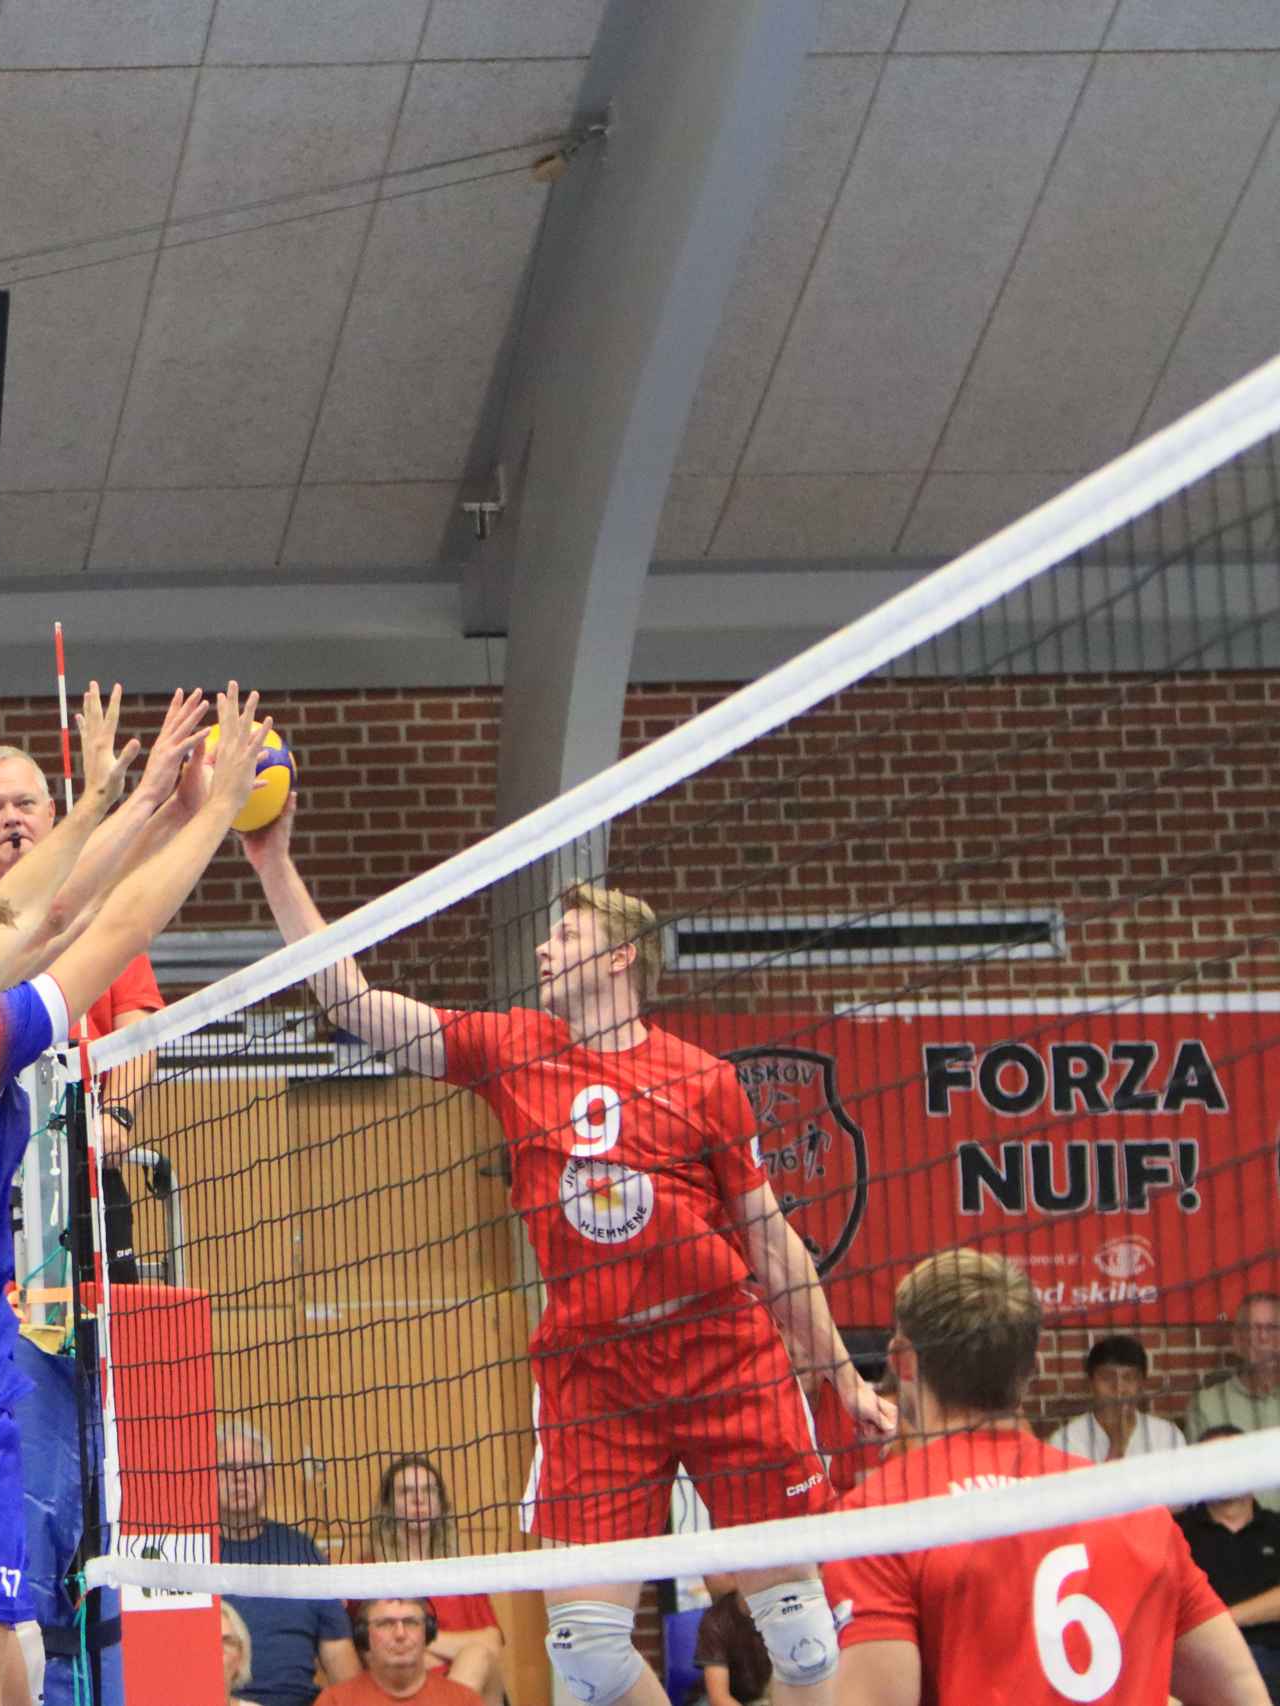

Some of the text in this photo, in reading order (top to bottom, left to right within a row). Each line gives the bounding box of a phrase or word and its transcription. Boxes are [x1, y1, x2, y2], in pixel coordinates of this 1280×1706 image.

[922, 1040, 1229, 1117] FORZA
[571, 1084, 620, 1157] 9
[956, 1138, 1202, 1215] NUIF!
[581, 1204, 648, 1239] HJEMMENE
[0, 1566, 21, 1599] 17
[1033, 1543, 1123, 1703] 6
